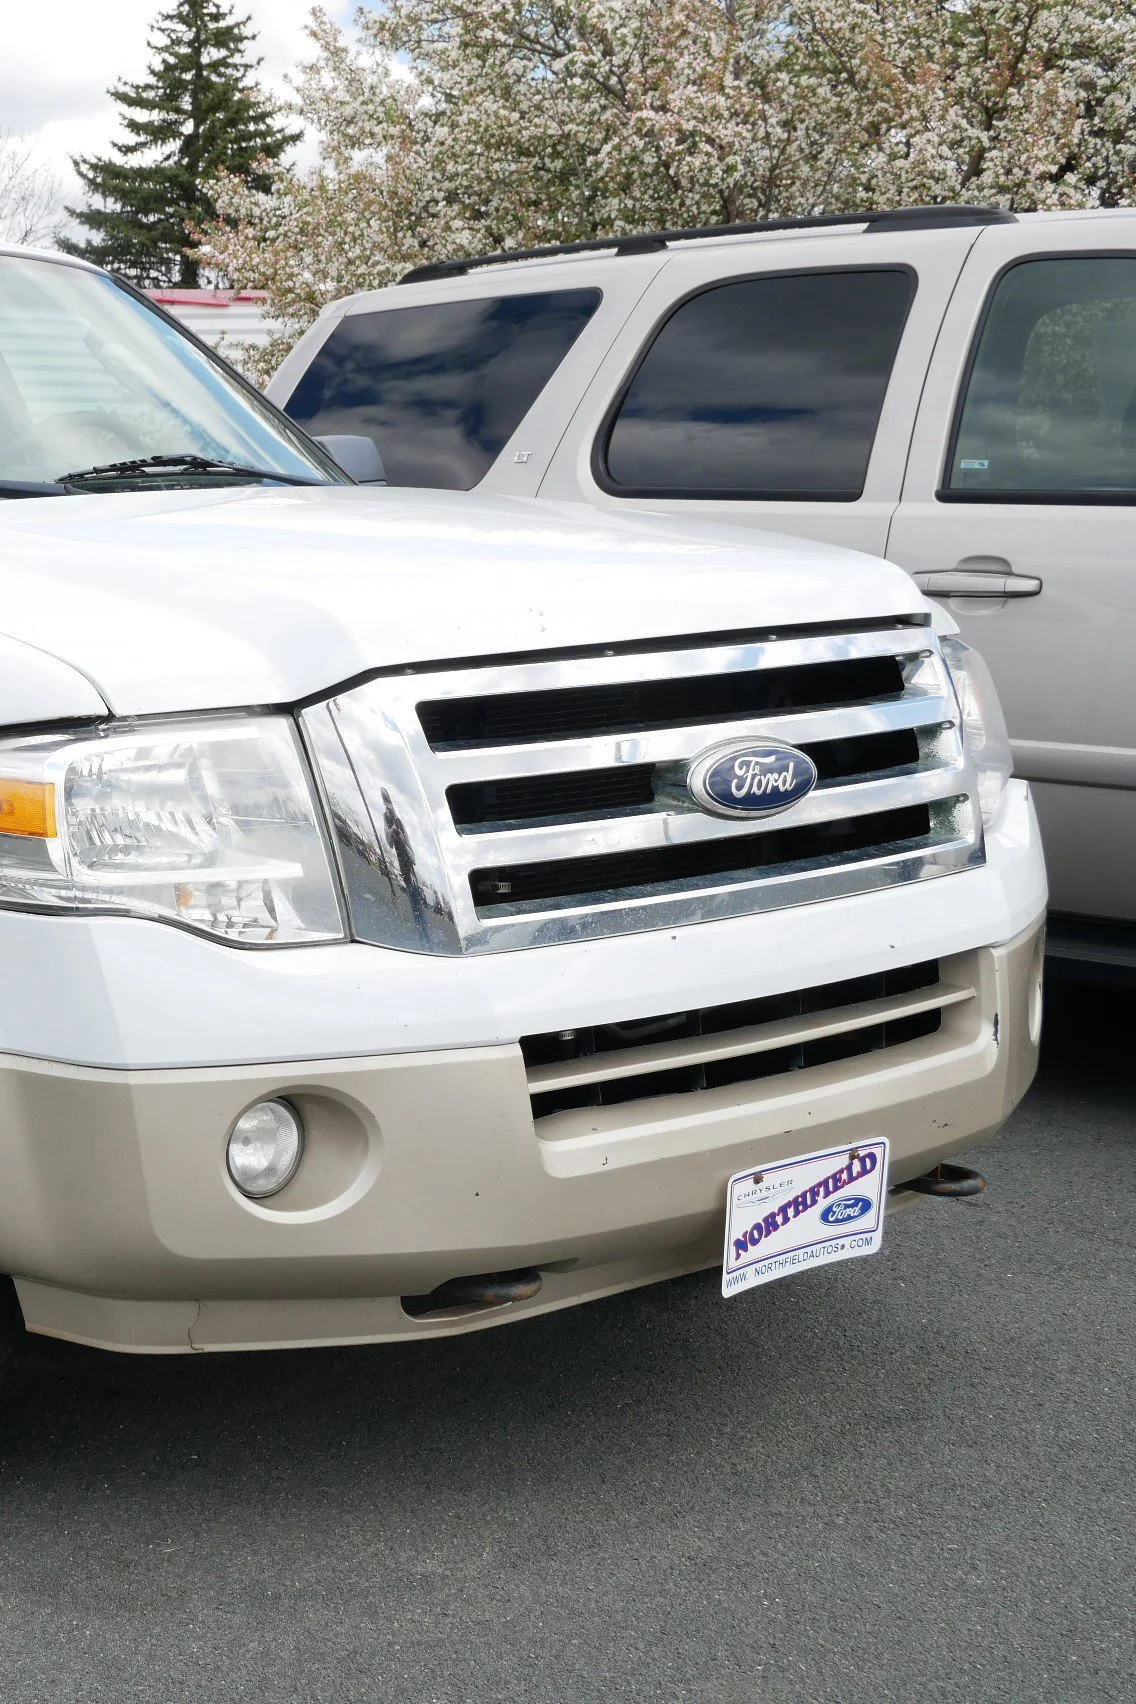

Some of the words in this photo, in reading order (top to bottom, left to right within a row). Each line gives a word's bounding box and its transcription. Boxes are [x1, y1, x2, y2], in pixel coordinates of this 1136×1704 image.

[514, 451, 532, 464] LT
[731, 754, 797, 799] Ford
[736, 1179, 794, 1202] CHRYSLER
[732, 1151, 878, 1262] NORTHFIELD
[828, 1200, 862, 1222] Ford
